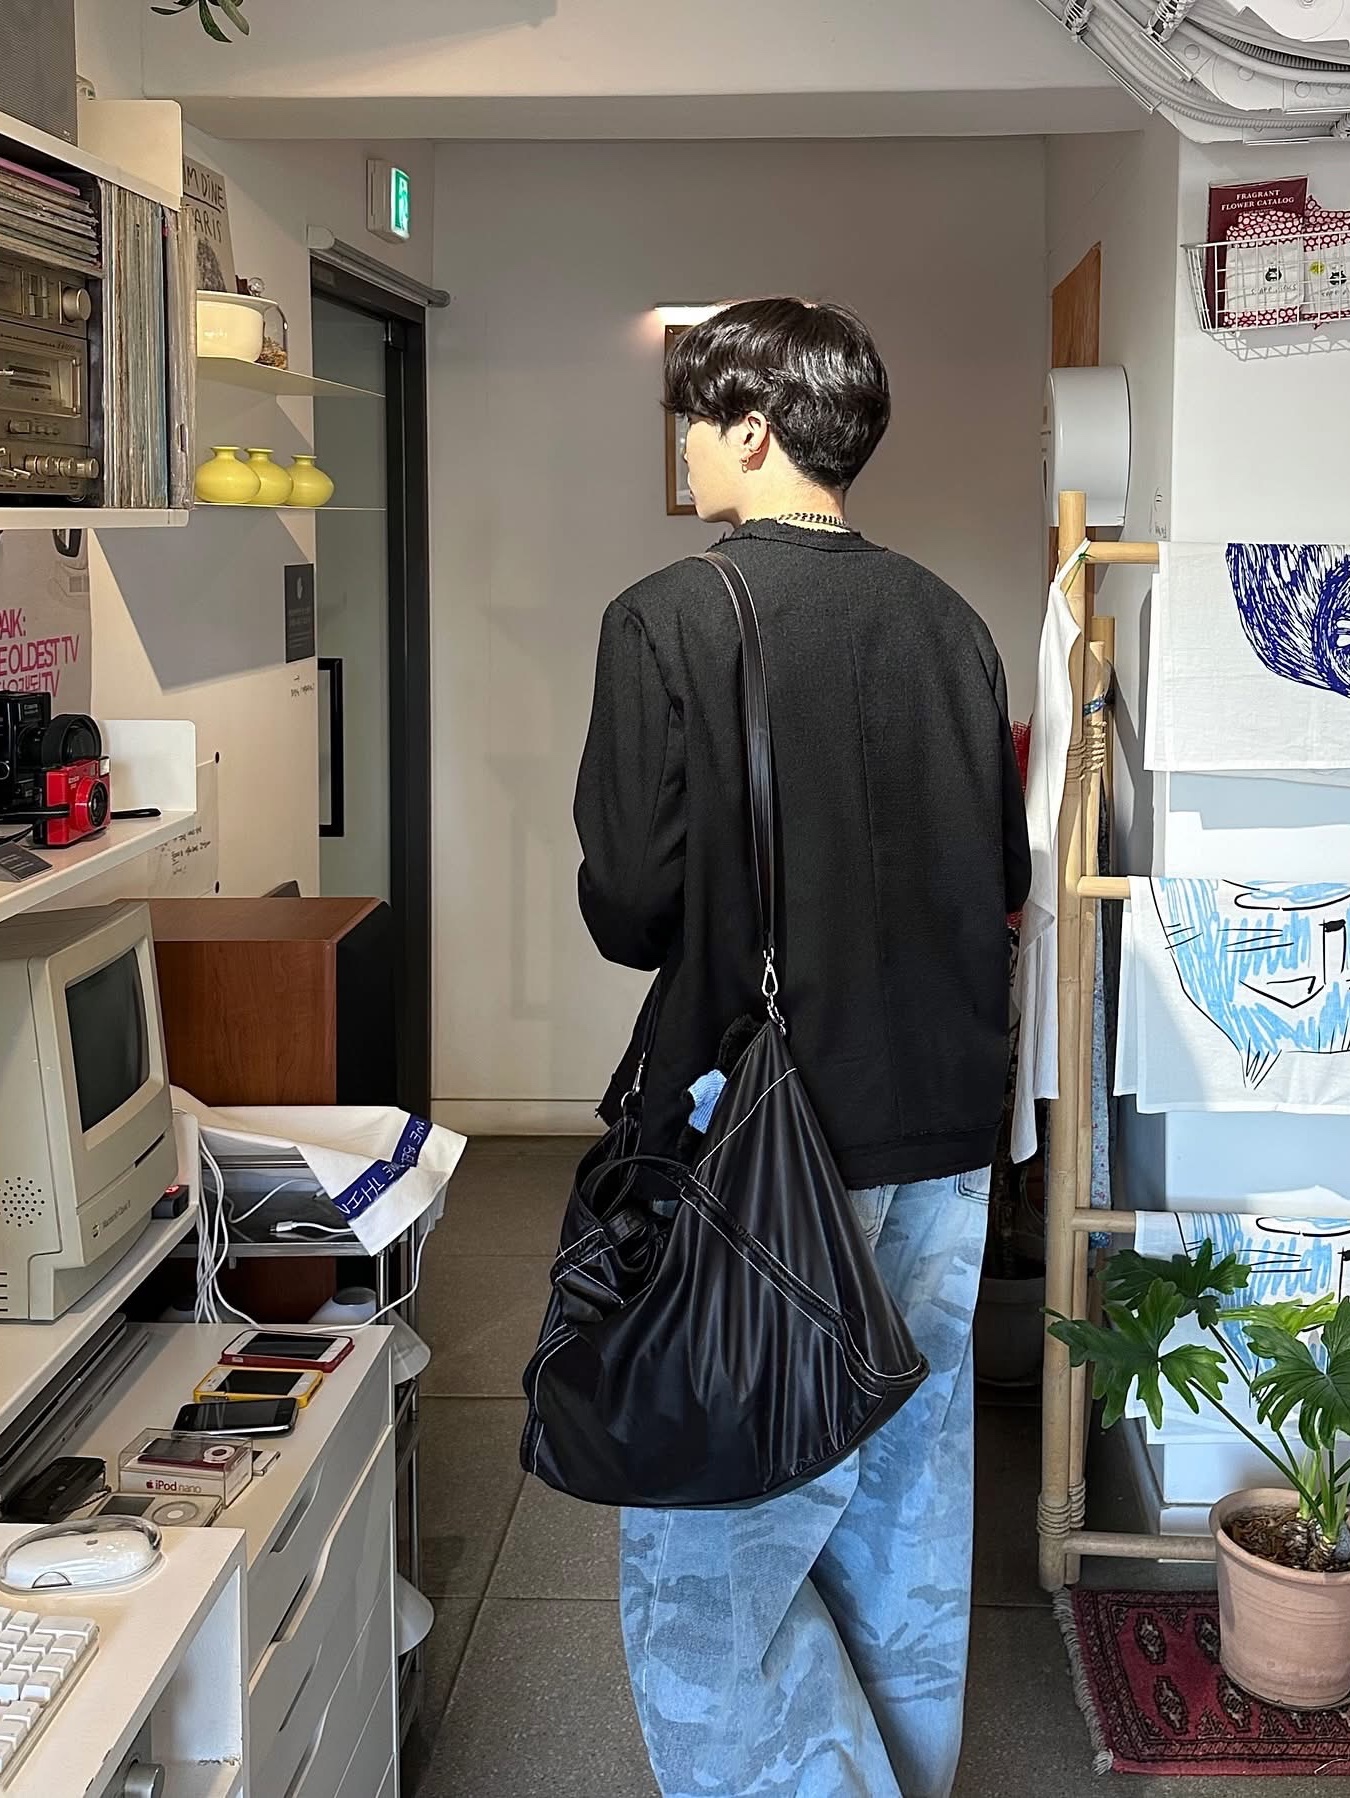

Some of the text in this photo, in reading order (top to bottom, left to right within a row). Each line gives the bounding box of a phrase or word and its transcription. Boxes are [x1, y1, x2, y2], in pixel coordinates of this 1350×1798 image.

[1221, 200, 1255, 211] FLOWER
[1256, 196, 1295, 207] CATALOG
[1236, 189, 1281, 200] FRAGRANT
[185, 203, 222, 243] ARIS
[0, 608, 26, 639] AIK:
[8, 638, 60, 674] OLDEST
[61, 635, 80, 664] TV
[42, 669, 60, 697] TV
[409, 1120, 426, 1145] WE
[155, 1480, 202, 1493] iPod nano
